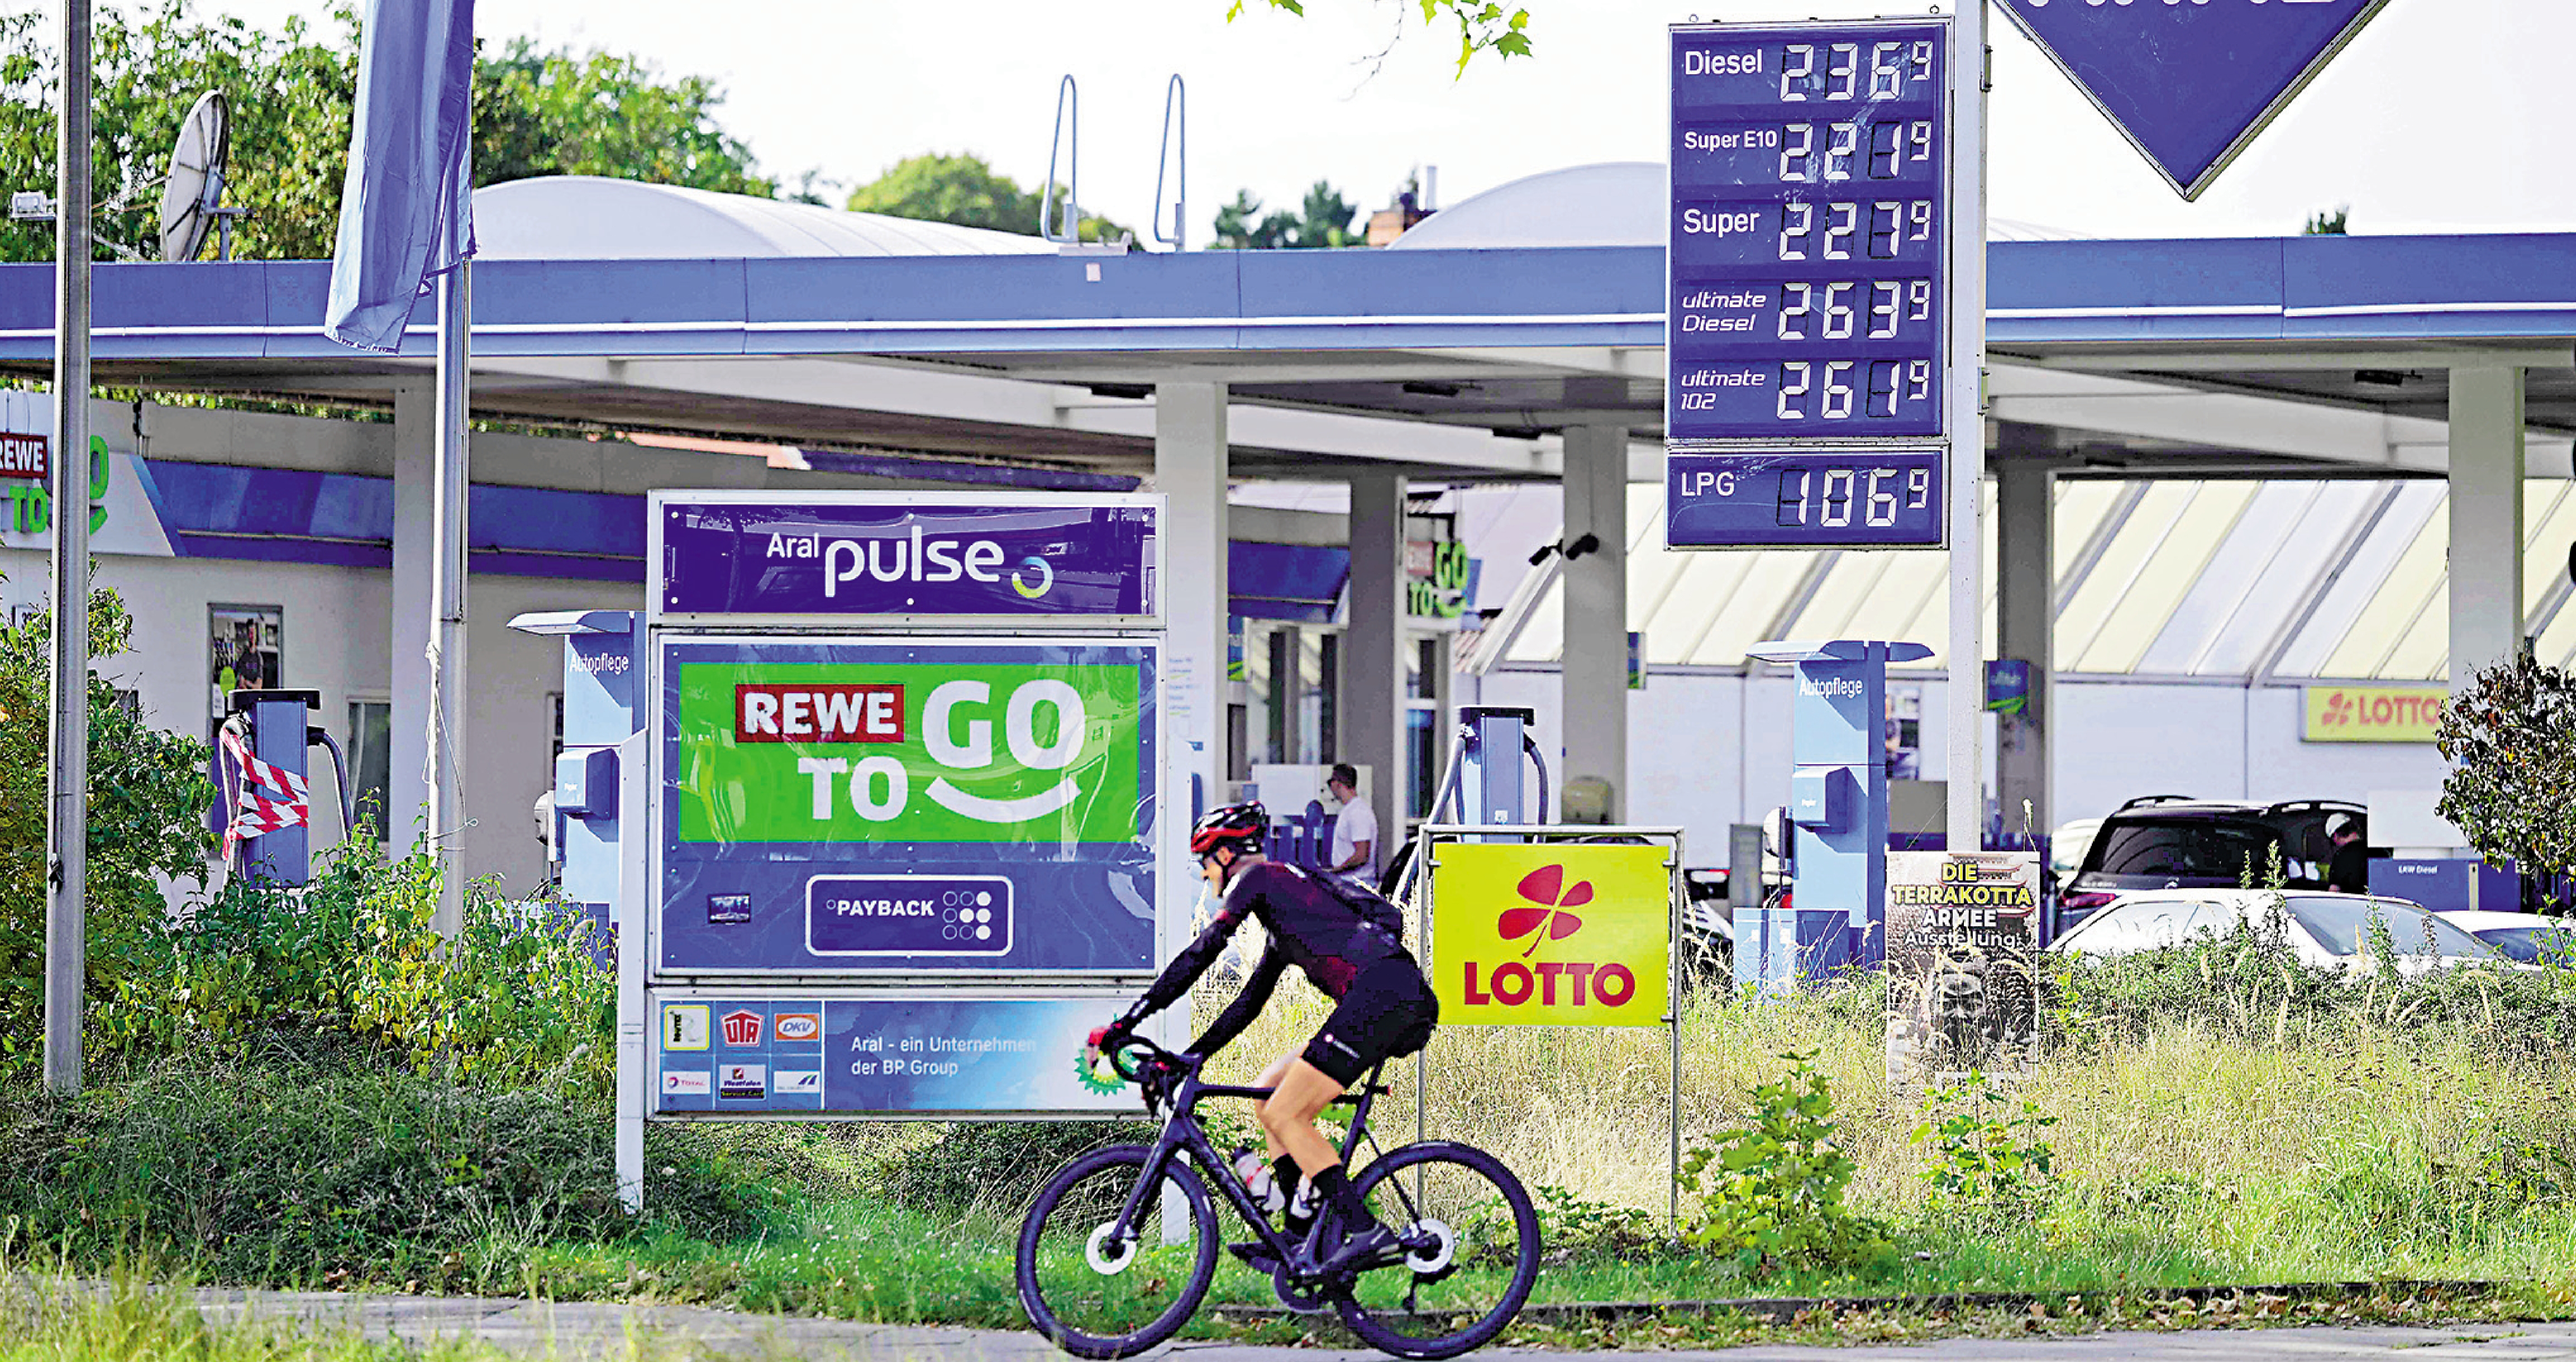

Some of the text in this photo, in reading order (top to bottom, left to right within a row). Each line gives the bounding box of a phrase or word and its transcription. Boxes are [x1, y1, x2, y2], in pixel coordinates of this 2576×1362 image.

[1685, 49, 1763, 75] Diesel
[1684, 131, 1741, 153] Super
[1744, 130, 1778, 148] E10
[1683, 208, 1761, 237] Super
[1681, 290, 1767, 308] ultimate
[1681, 313, 1757, 332] Diesel
[1681, 369, 1766, 387] ultimate
[1681, 392, 1716, 410] 102
[0, 439, 44, 472] EWE
[1681, 472, 1735, 497] LPG
[9, 485, 49, 533] TO
[766, 526, 1005, 598] Aral pulse
[569, 653, 630, 674] Autopflege
[1799, 677, 1863, 699] Autopflege
[743, 690, 898, 735] REWE
[2359, 696, 2440, 726] LOTTO
[922, 679, 1086, 770] GO
[798, 756, 909, 822] TO
[1941, 863, 1978, 882] DIE
[1892, 885, 2034, 906] TERRAKOTTA
[837, 899, 935, 917] PAYBACK
[1922, 908, 1997, 928] ARMEE
[1464, 961, 1635, 1007] LOTTO
[724, 1012, 760, 1043] UTA
[783, 1022, 812, 1032] DKV
[851, 1036, 882, 1052] Aral
[900, 1036, 924, 1052] ein
[929, 1036, 1037, 1052] Unternehmen
[851, 1059, 960, 1077] der BP Group
